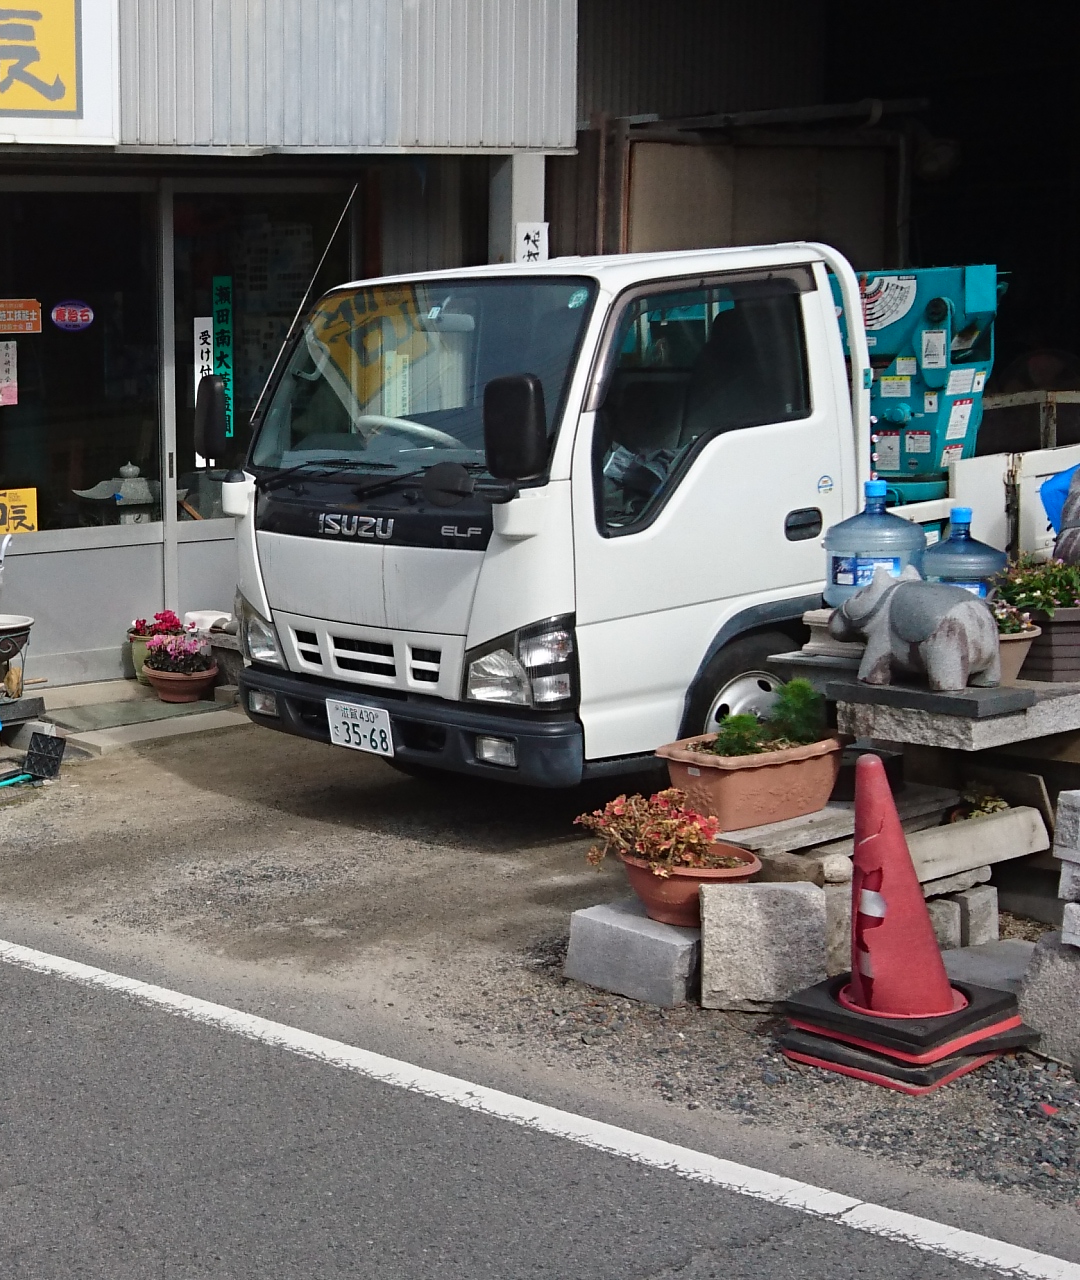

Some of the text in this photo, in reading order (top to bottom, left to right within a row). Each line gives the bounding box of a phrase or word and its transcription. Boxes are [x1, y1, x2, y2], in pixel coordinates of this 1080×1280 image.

[319, 513, 394, 539] ISUZU
[441, 526, 482, 537] ELF
[342, 721, 388, 751] 35-68
